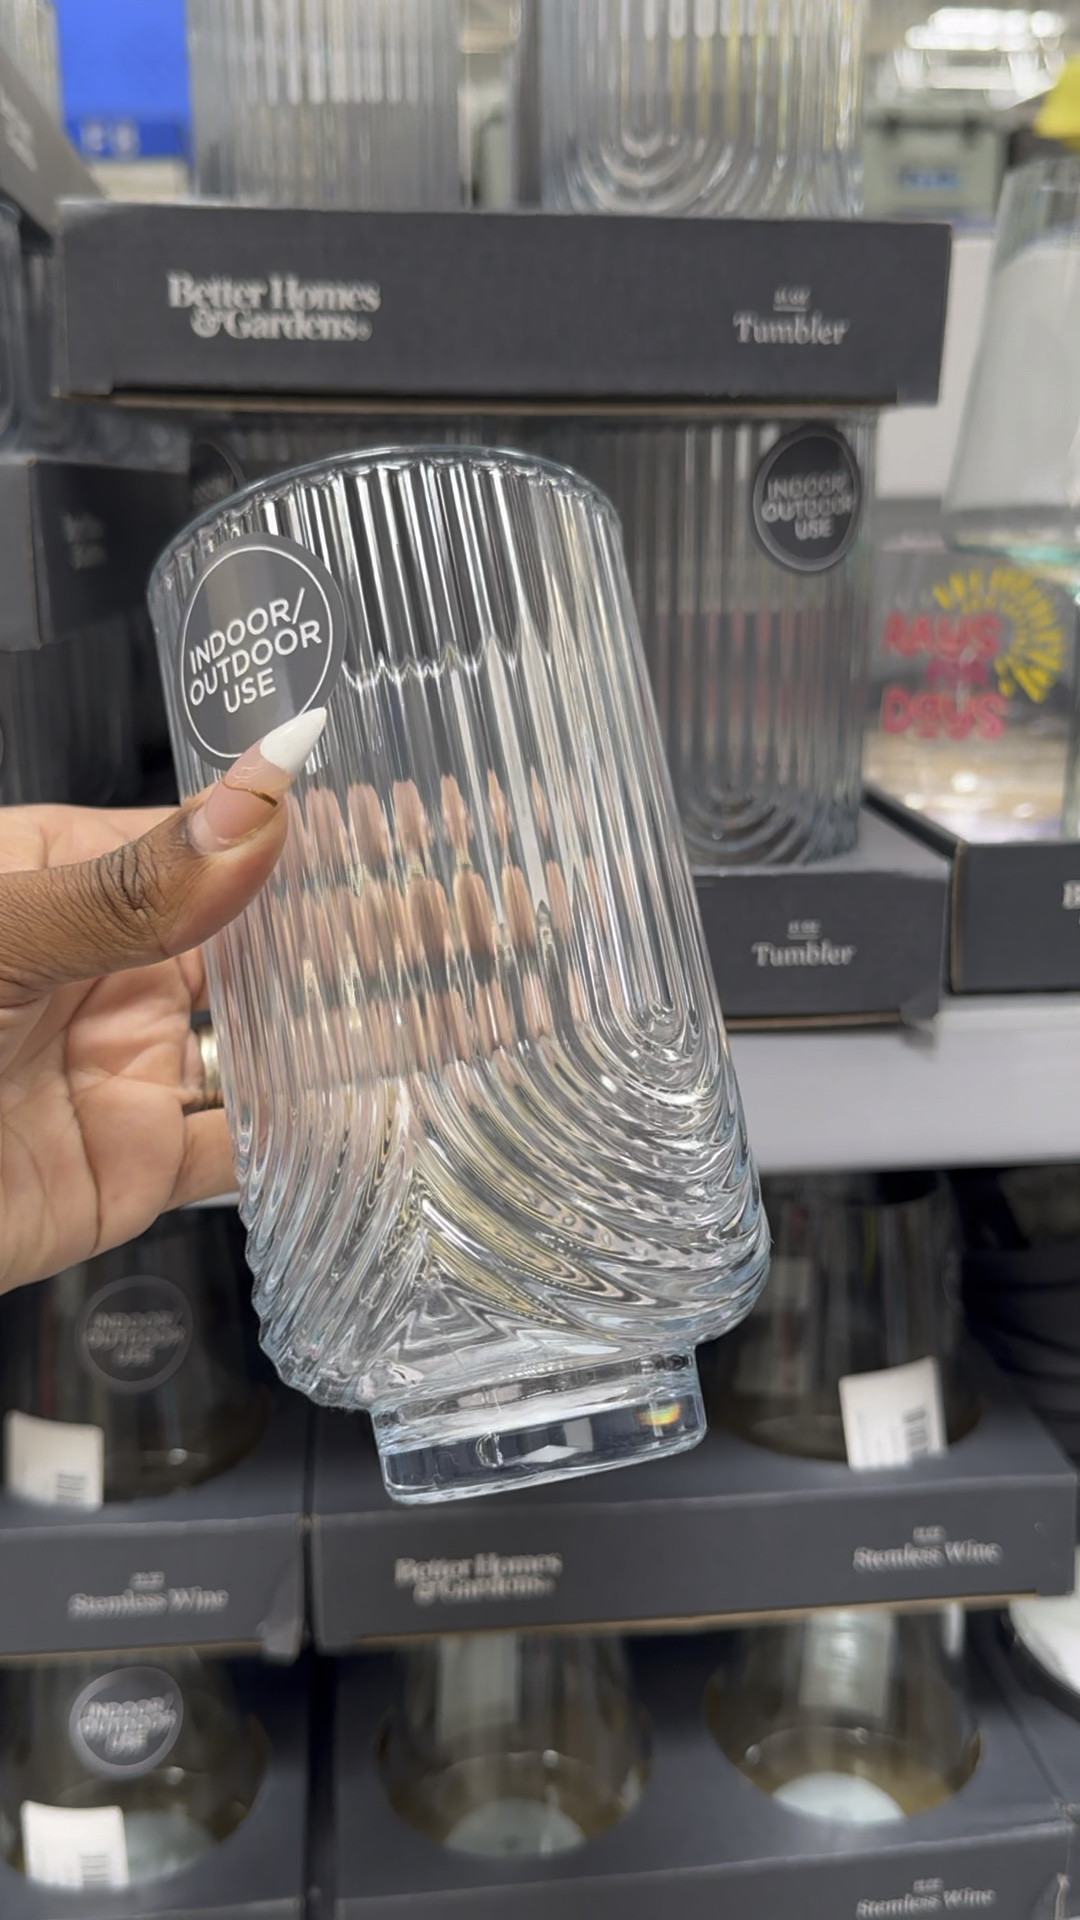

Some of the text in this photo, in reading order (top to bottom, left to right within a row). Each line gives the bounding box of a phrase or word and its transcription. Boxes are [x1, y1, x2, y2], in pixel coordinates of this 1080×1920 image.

[167, 271, 381, 312] Better Homes
[733, 310, 848, 345] Tumbler
[190, 587, 305, 675] INDOOR/
[190, 620, 322, 706] OUTDOOR
[224, 668, 276, 713] USE
[752, 938, 856, 967] Tumbler
